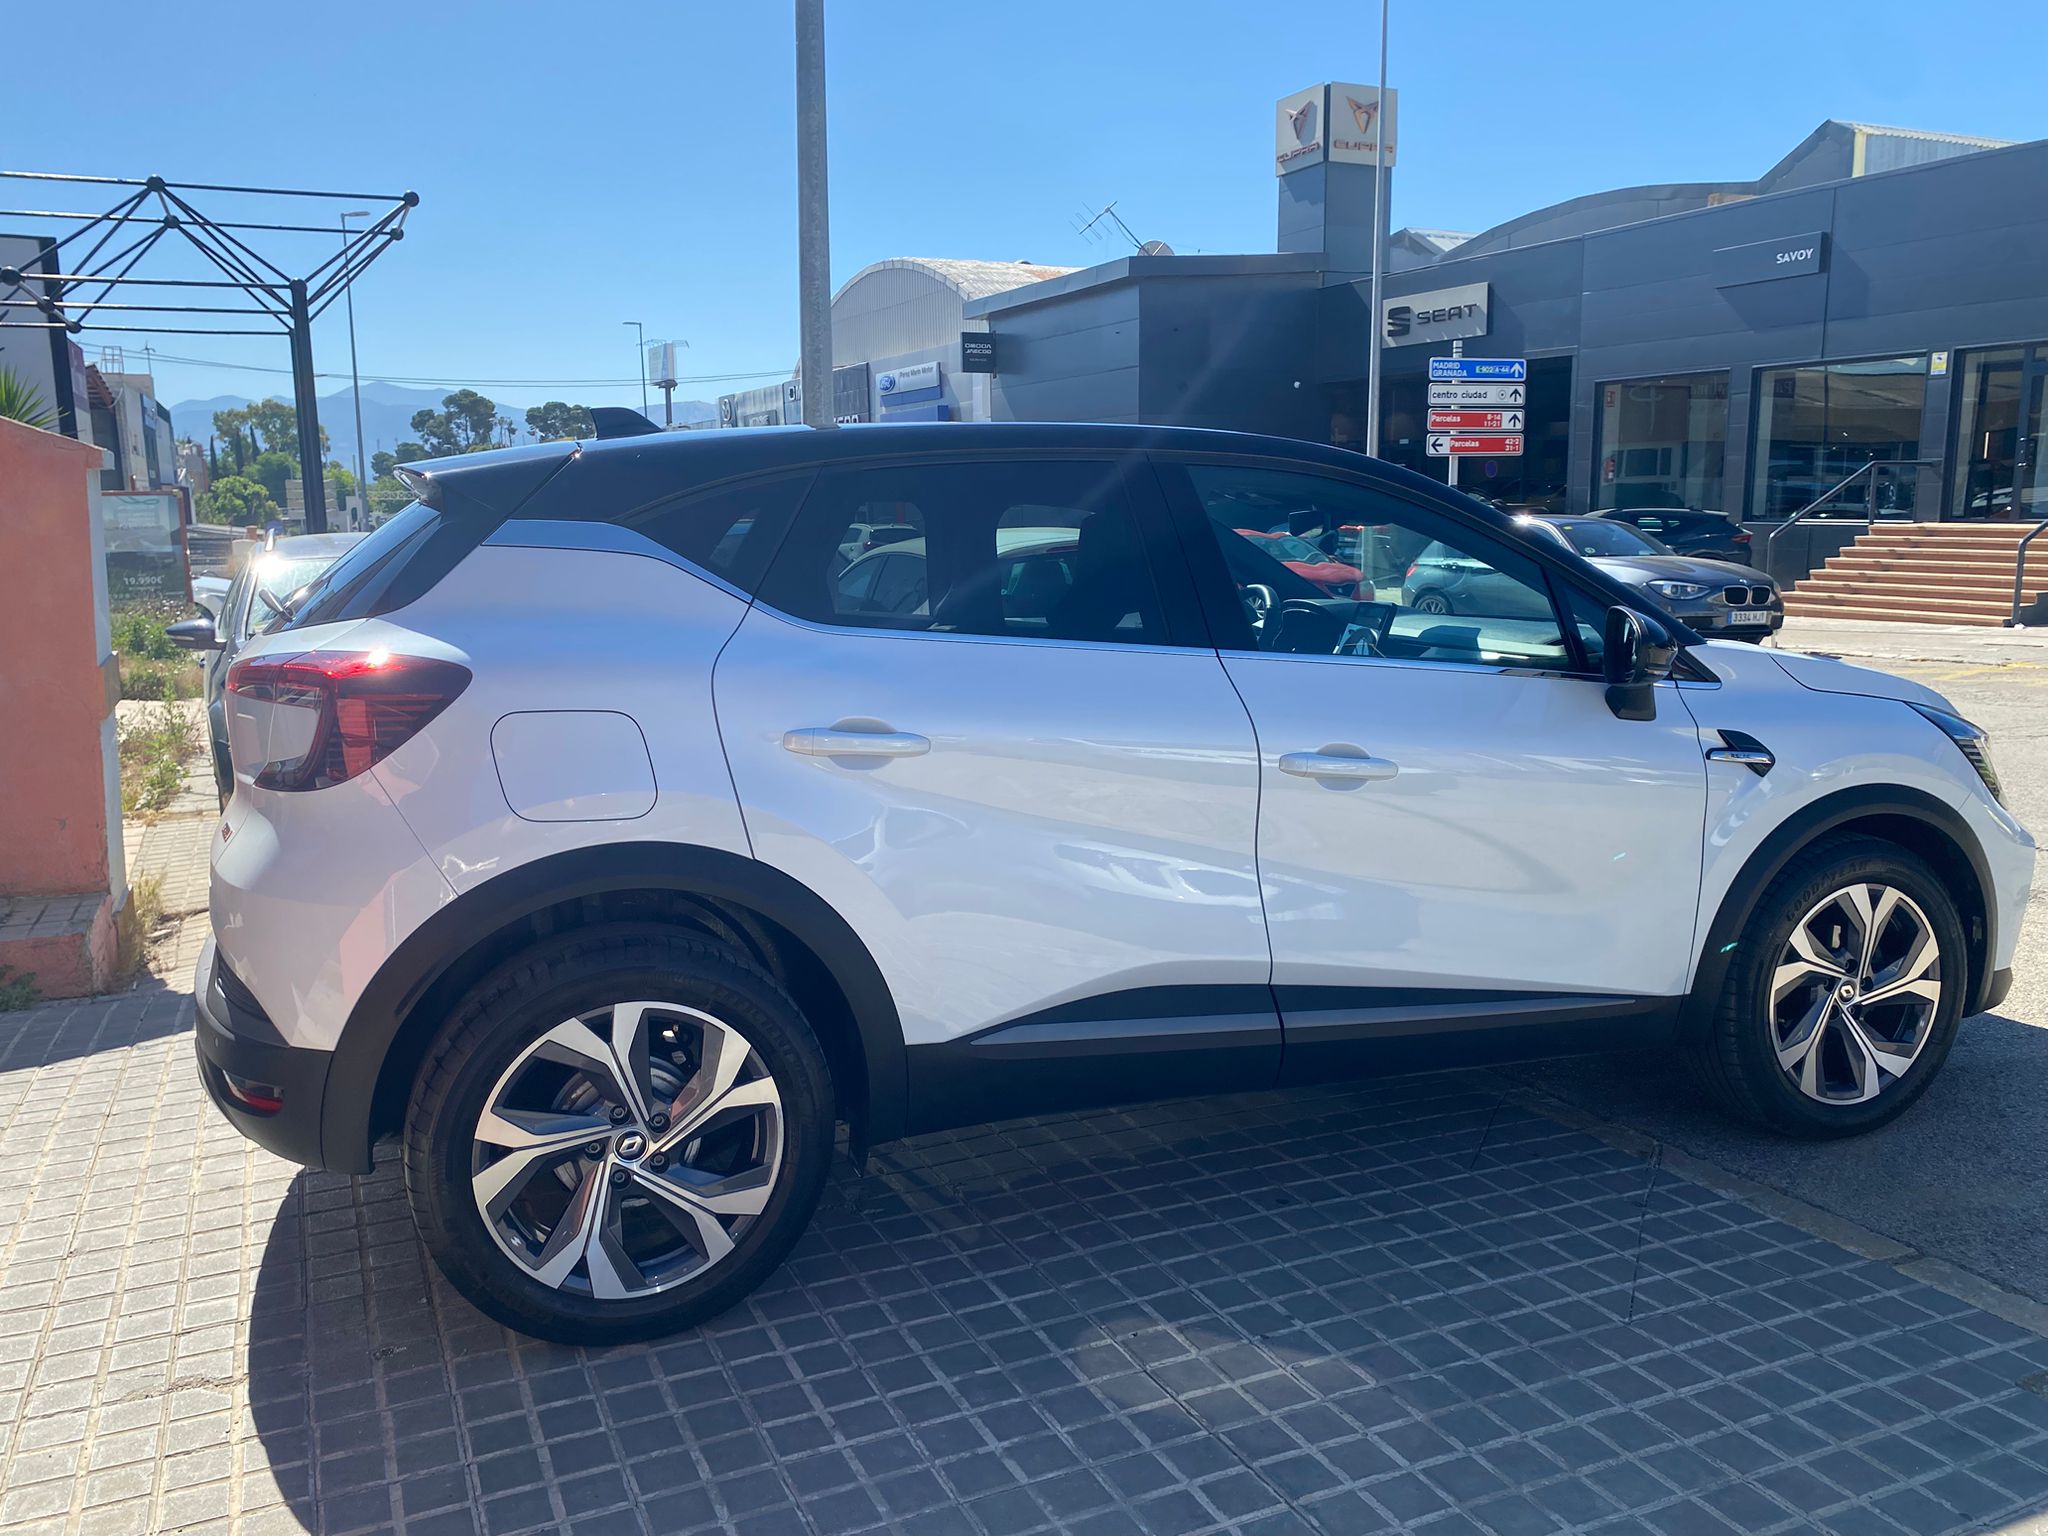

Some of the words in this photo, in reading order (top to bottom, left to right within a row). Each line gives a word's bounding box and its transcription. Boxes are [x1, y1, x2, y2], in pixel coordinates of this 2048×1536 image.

[1776, 248, 1814, 264] SAVOY
[1416, 303, 1478, 325] SEAT
[1432, 369, 1468, 377] GRANADA
[1432, 391, 1458, 399] centro
[1461, 390, 1488, 399] ciudad
